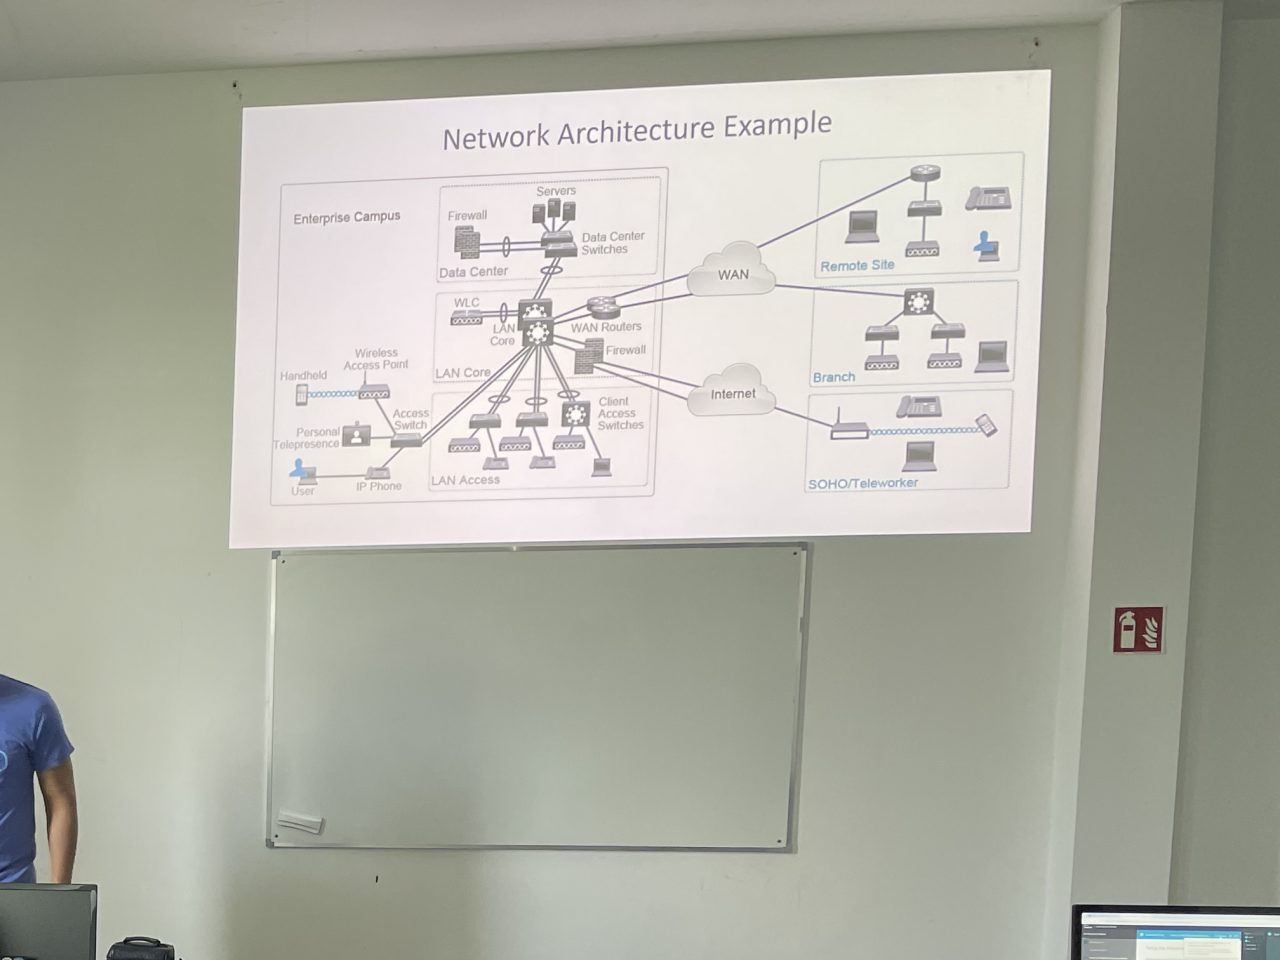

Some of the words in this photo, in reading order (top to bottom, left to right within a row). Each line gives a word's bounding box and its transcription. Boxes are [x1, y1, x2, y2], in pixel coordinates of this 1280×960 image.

[443, 123, 549, 151] Network
[557, 118, 715, 147] Architecture
[724, 110, 832, 139] Example
[536, 185, 576, 196] Servers
[293, 212, 350, 227] Enterprise
[354, 210, 400, 224] Campus
[448, 210, 487, 220] Firewall
[581, 232, 607, 242] Data
[610, 231, 645, 241] Center
[581, 244, 628, 255] Switches
[820, 261, 868, 272] Remote
[872, 258, 895, 270] Site
[439, 267, 466, 278] Data
[469, 266, 508, 276] Center
[718, 269, 749, 281] WAN
[454, 298, 479, 307] WLC
[493, 324, 515, 334] LAN
[571, 322, 597, 332] WAN
[601, 321, 641, 331] Routers
[490, 336, 515, 346] Core
[354, 347, 398, 358] Wireless
[606, 344, 646, 355] Firewall
[344, 359, 380, 370] Access
[383, 358, 408, 369] Point
[280, 370, 327, 381] Handheld
[435, 368, 459, 378] LAN
[462, 367, 491, 377] Core
[813, 372, 855, 383] Branch
[711, 388, 756, 400] Internet
[598, 396, 629, 407] Client
[393, 408, 429, 419] Access
[598, 408, 636, 419] Access
[394, 420, 427, 430] Switch
[598, 420, 644, 430] Switches
[296, 427, 340, 437] Personal
[273, 438, 340, 451] Telepresence
[431, 475, 454, 485] LAN
[459, 474, 500, 485] Access
[808, 478, 919, 490] SOHO/Teleworker
[291, 485, 315, 496] User
[356, 482, 366, 491] IP
[368, 480, 402, 491] Phone
